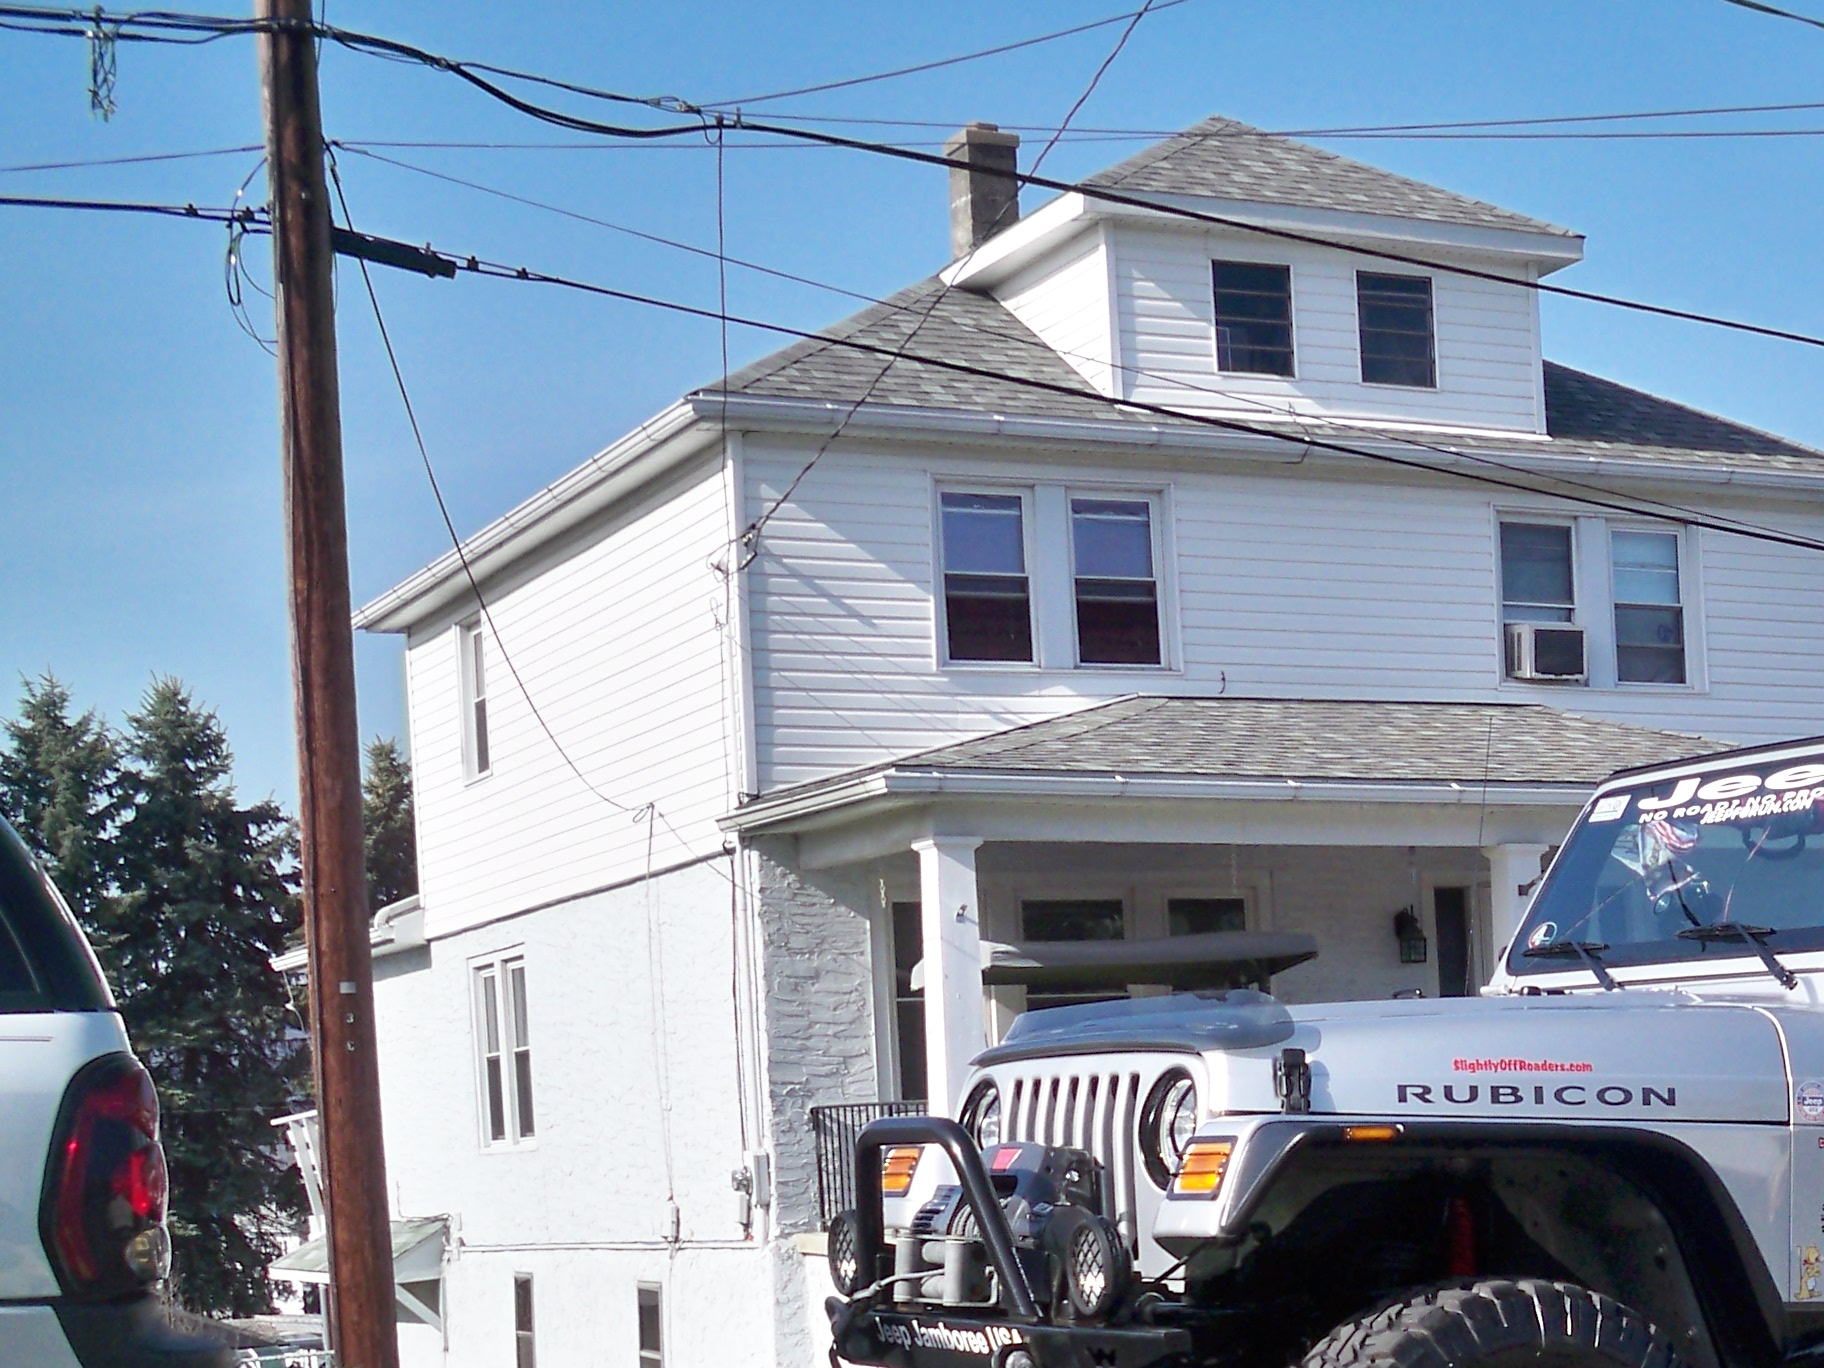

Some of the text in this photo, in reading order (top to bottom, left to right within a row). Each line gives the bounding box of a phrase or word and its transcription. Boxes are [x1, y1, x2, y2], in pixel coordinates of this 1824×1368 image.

[1638, 809, 1667, 823] NO
[1453, 1059, 1593, 1074] SlightlyOffRoaders.com
[1397, 1084, 1677, 1107] RUBICON
[874, 1315, 1023, 1355] Jeep Jamboree USA
